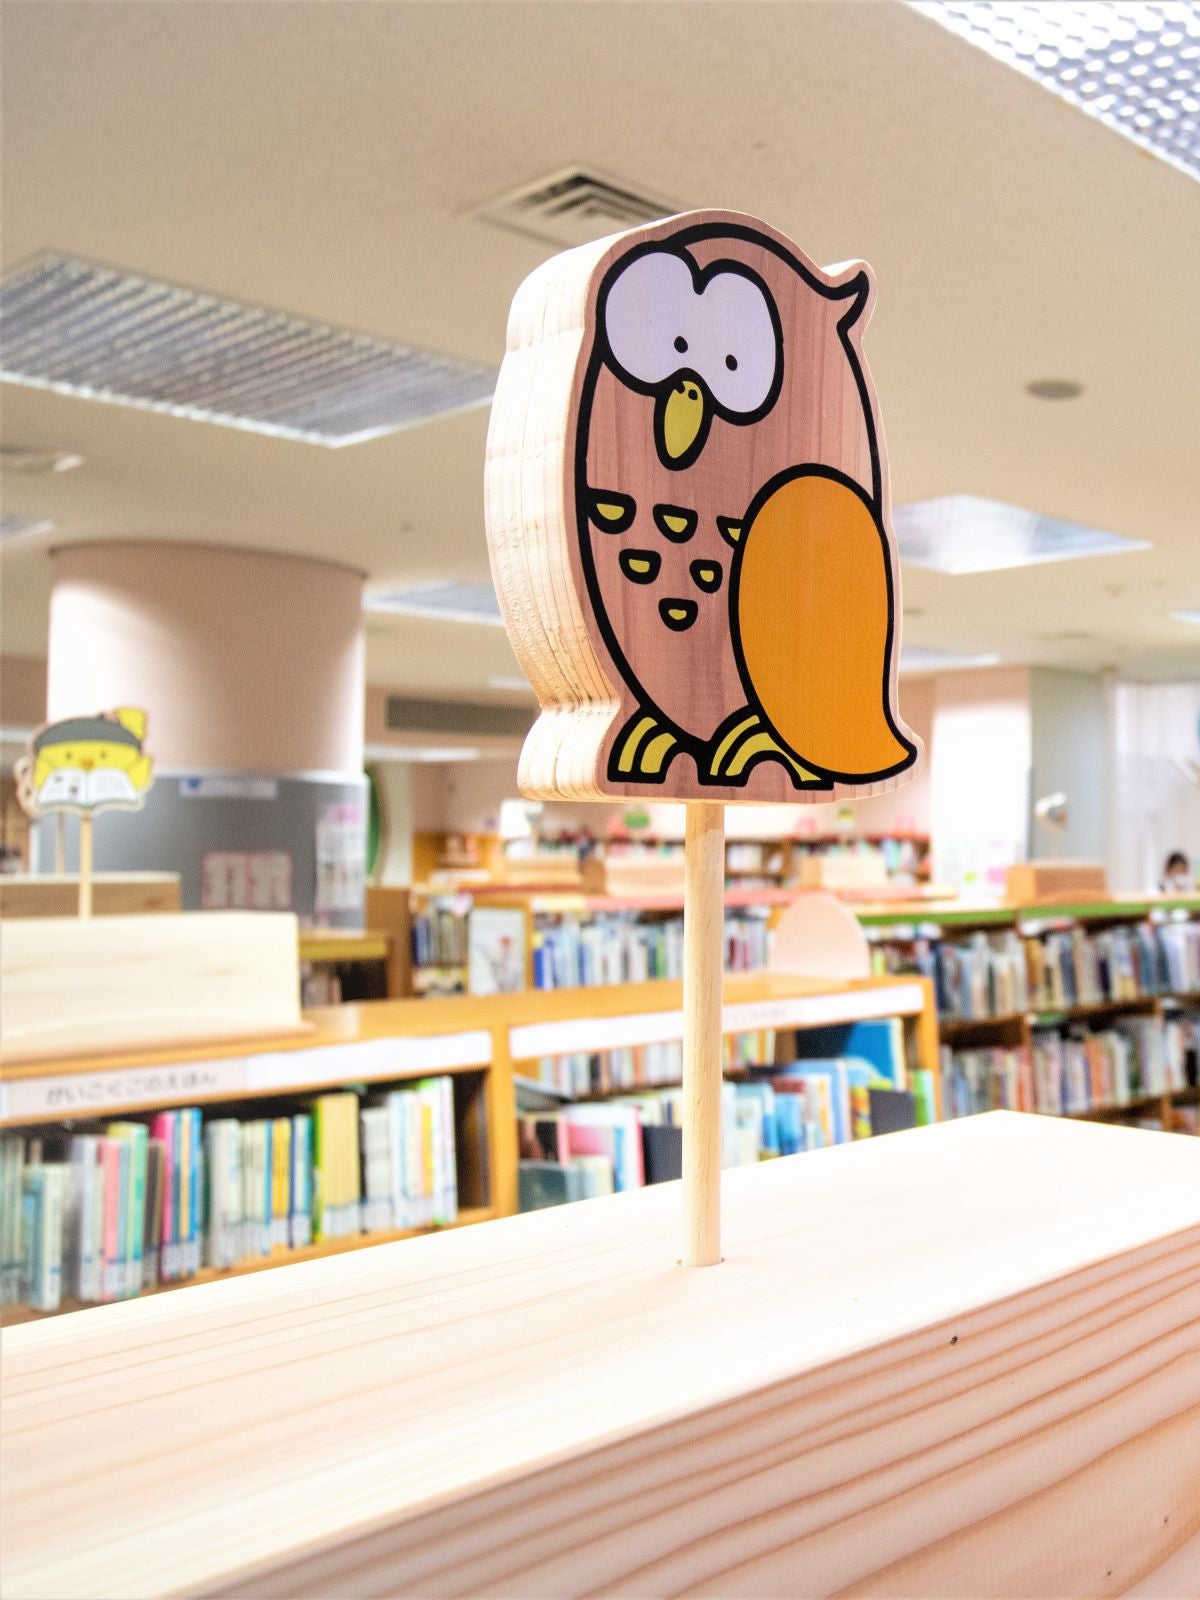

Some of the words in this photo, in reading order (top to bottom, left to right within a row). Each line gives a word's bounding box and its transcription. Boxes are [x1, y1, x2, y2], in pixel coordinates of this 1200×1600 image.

[46, 1072, 217, 1105] がいこくごのえほん
